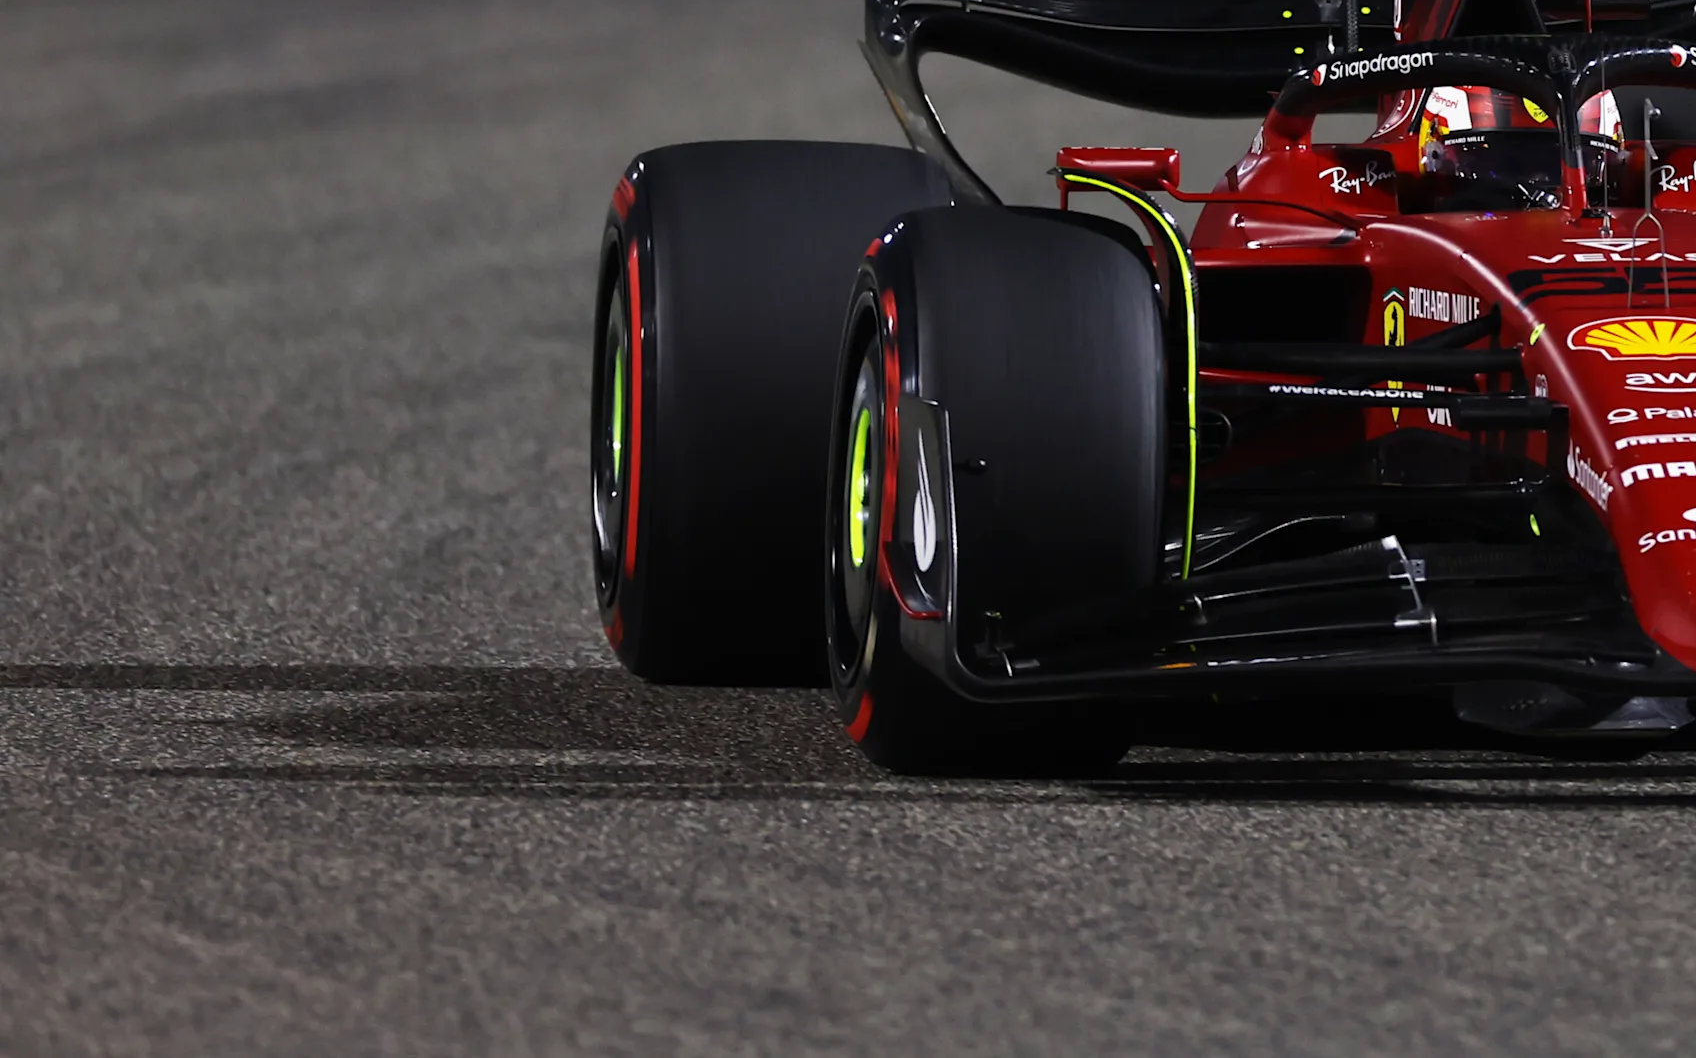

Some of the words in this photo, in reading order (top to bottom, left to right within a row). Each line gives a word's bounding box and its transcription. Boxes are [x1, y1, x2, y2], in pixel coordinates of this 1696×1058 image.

[1329, 51, 1434, 80] Snapdragon
[1318, 160, 1397, 195] Ray-Ban
[1408, 286, 1450, 323] RICHARD
